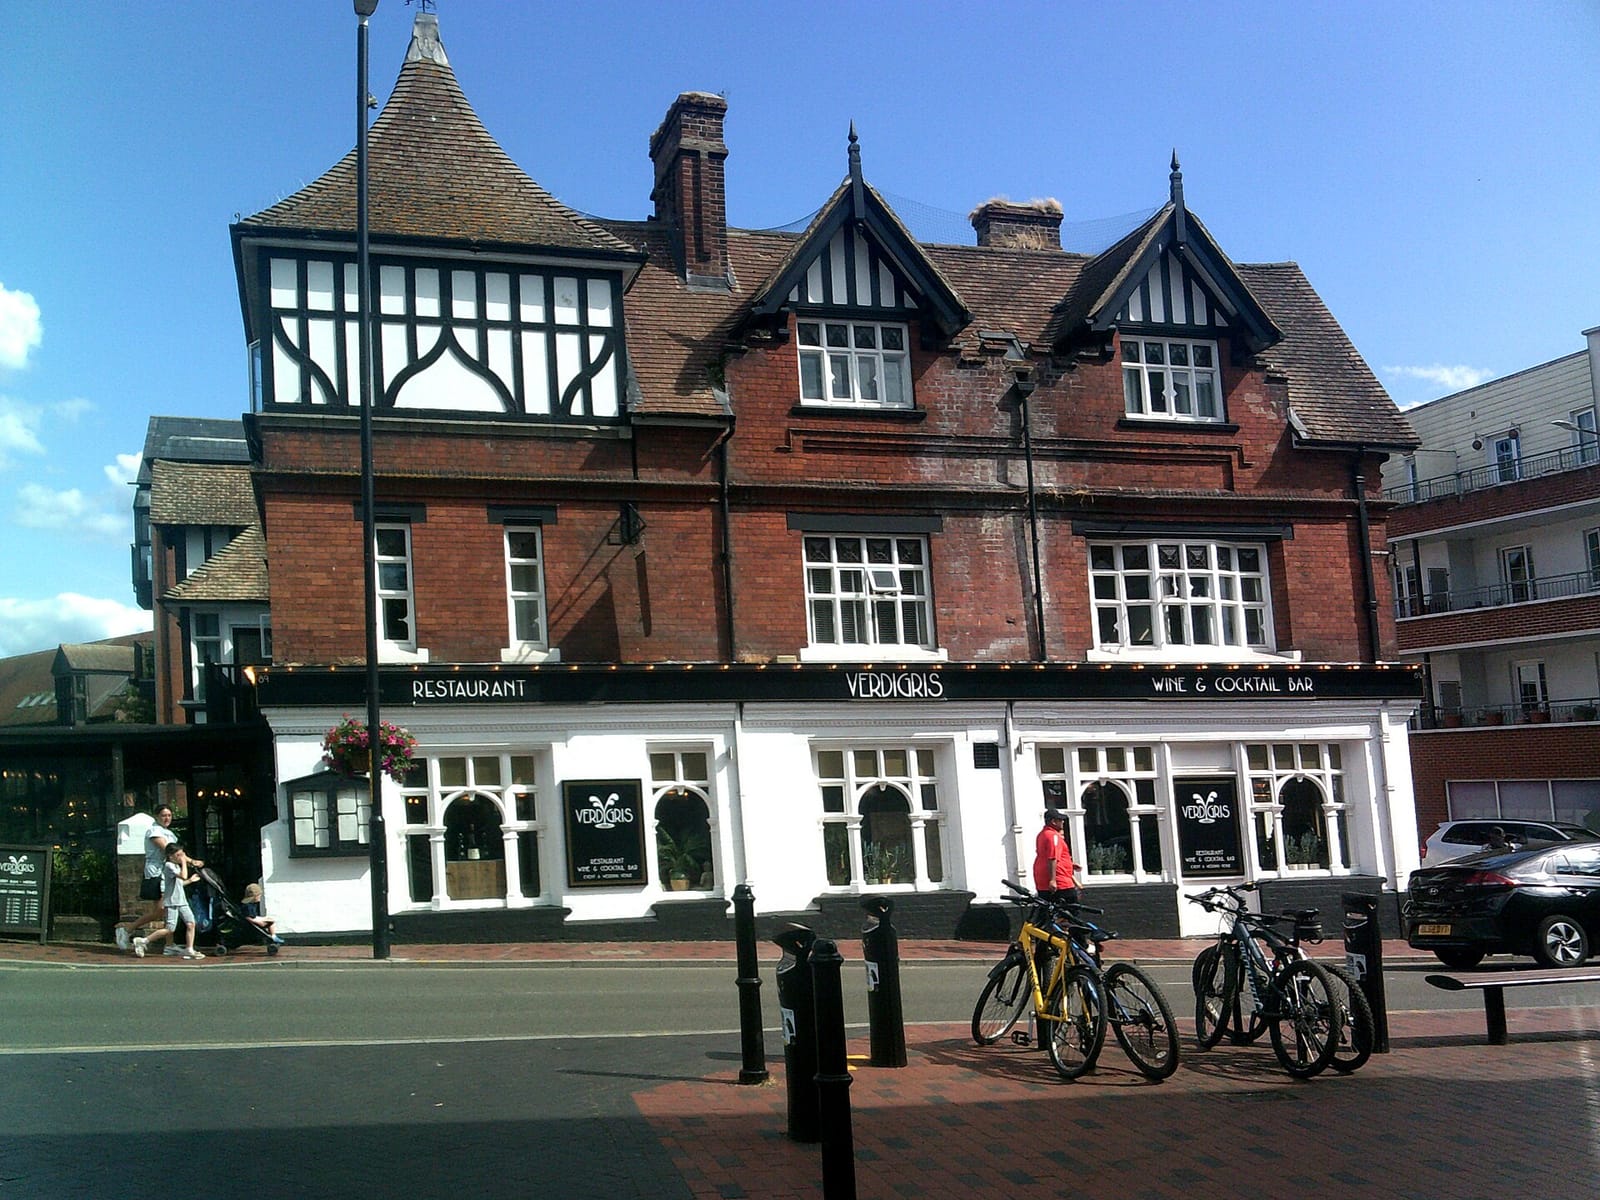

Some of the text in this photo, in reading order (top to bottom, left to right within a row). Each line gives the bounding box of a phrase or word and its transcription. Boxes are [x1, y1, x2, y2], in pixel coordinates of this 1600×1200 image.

[412, 680, 526, 698] RESTAURANT
[845, 673, 943, 698] VERDIGRIS
[1152, 676, 1314, 692] WINE & COCKTAIL BAR
[590, 857, 624, 865] RESTAURANT
